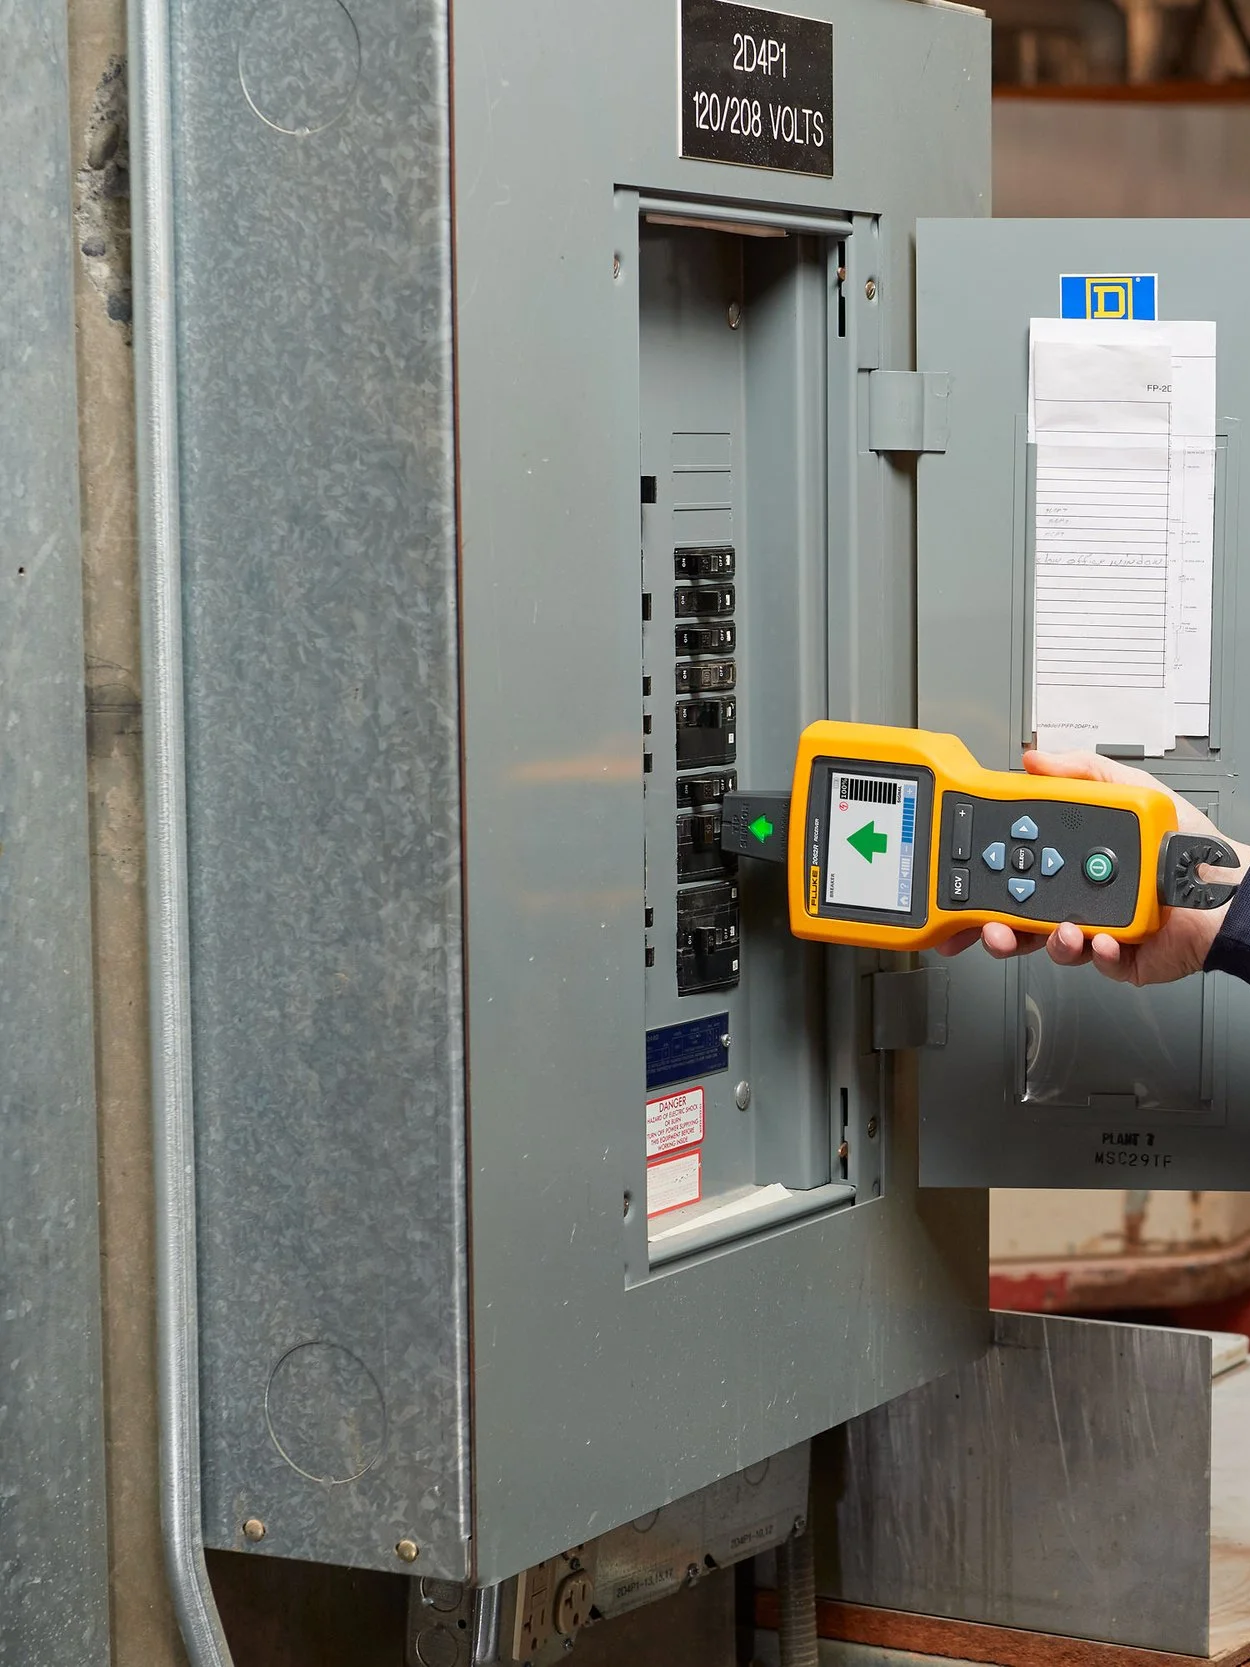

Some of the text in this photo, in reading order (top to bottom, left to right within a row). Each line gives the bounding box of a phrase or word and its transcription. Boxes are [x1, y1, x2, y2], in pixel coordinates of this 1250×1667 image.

[733, 33, 787, 78] 2D4P1
[693, 91, 824, 147] 120/208 VOLTS
[811, 870, 819, 907] FLUKE
[955, 876, 963, 895] NCV
[659, 1096, 687, 1113] DANGER
[1102, 1133, 1140, 1146] PLANT
